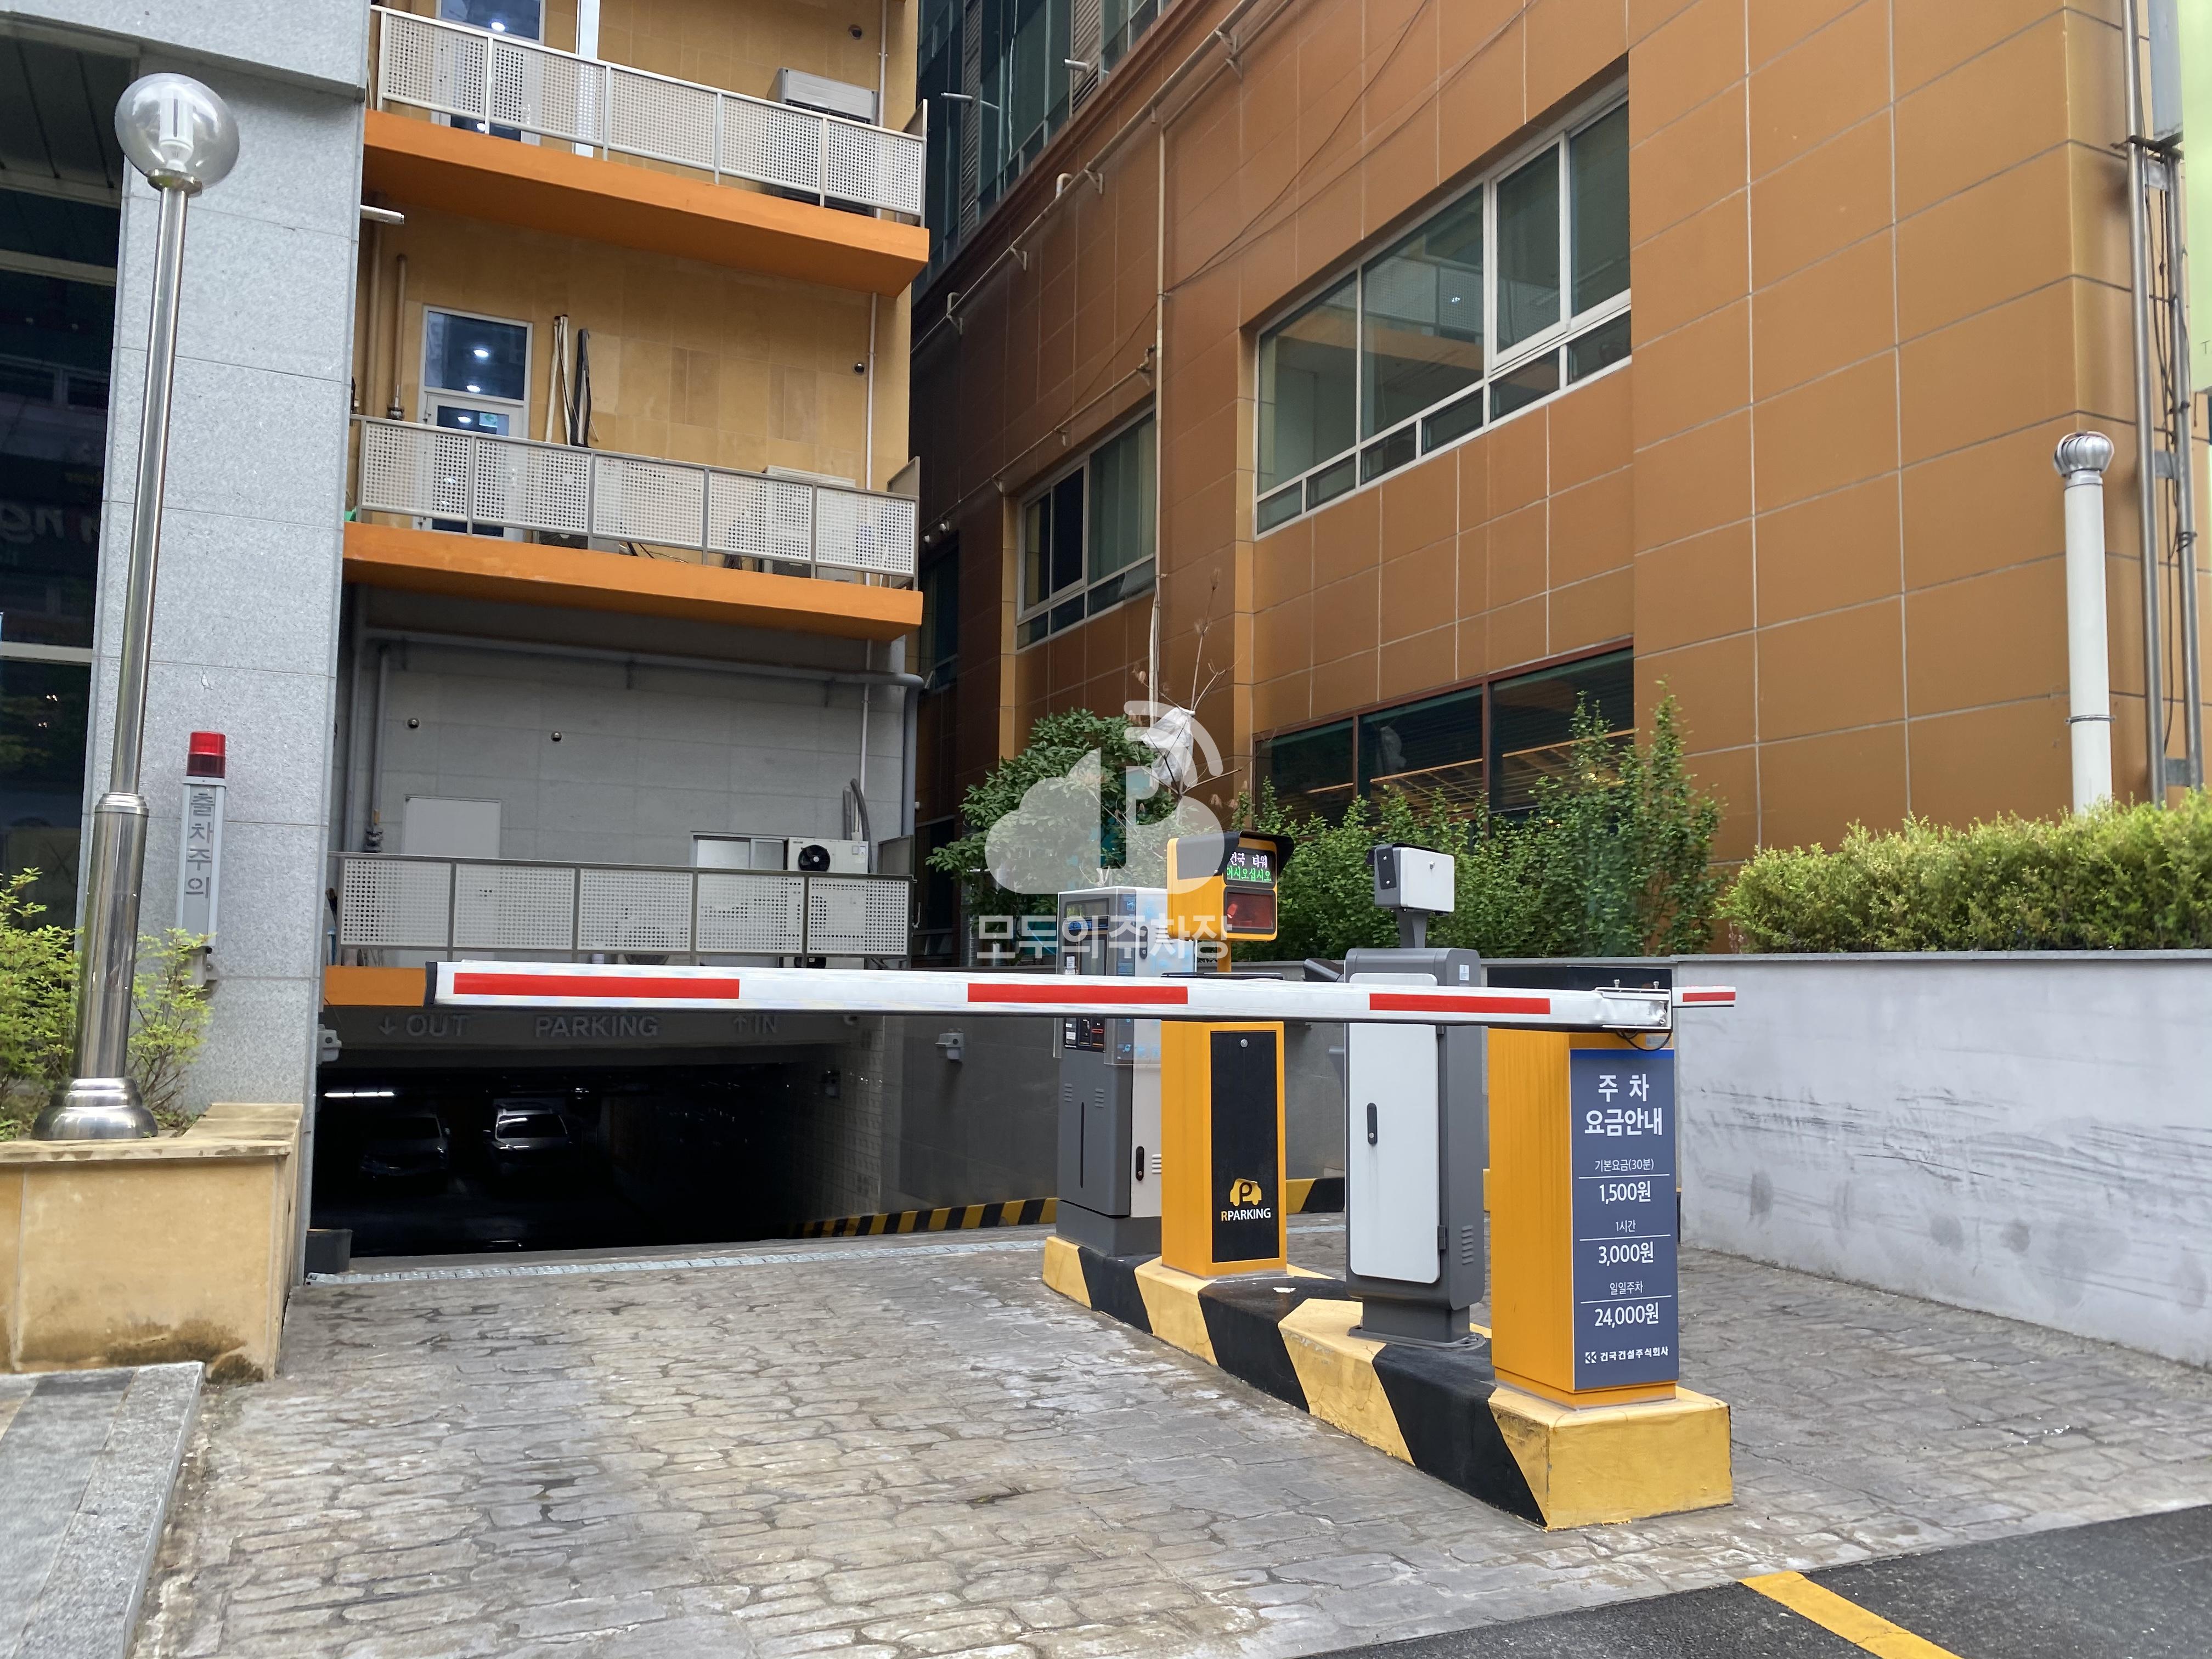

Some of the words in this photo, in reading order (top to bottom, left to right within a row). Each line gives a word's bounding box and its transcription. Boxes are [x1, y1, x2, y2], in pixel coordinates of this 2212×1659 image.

[185, 792, 215, 899] 출차주의
[1252, 854, 1267, 869] 타워
[1227, 865, 1272, 882] 어서오십시오
[406, 1014, 470, 1036] OUT
[535, 1015, 658, 1037] PARKING
[754, 1014, 777, 1034] IN
[1584, 1107, 1662, 1136] 요금안내
[1594, 1159, 1654, 1172] 기본요금(30분)
[1599, 1181, 1651, 1205] 1,500원
[1221, 1208, 1271, 1222] RPARKING
[1615, 1219, 1636, 1233] 1시간
[1598, 1241, 1654, 1267] 3,000원
[1610, 1280, 1644, 1295] 일일주차
[1595, 1302, 1659, 1328] 24,000원
[1600, 1346, 1669, 1362] 건국건설주식회사
